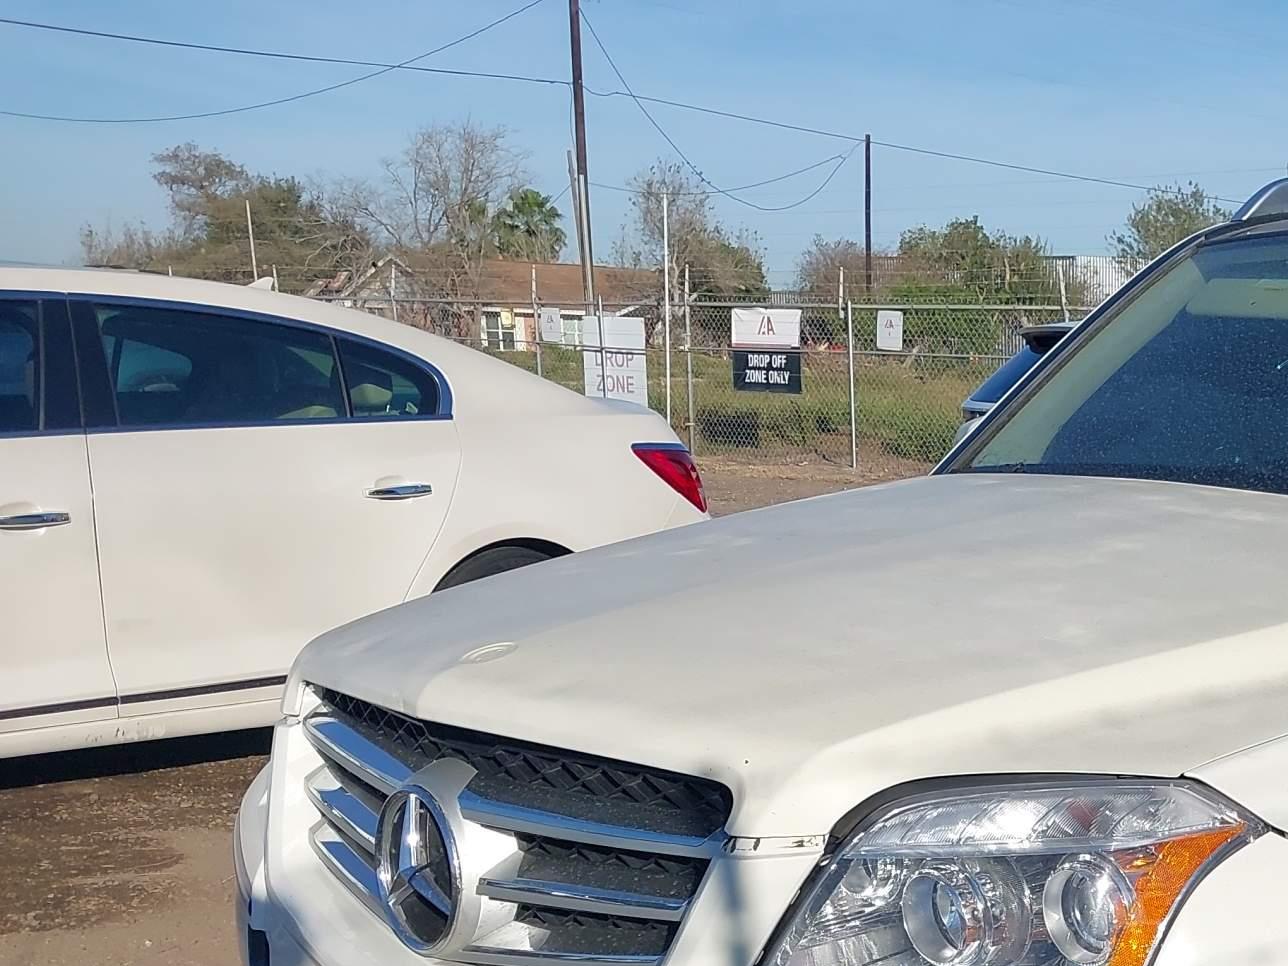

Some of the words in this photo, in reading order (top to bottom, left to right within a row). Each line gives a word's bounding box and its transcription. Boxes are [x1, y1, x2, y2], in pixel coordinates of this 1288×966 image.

[595, 351, 634, 368] DROP
[747, 354, 770, 368] DROP
[771, 355, 787, 368] OFF
[596, 374, 635, 394] ZONE
[744, 369, 767, 383] ZONE
[768, 370, 790, 384] ONLY
